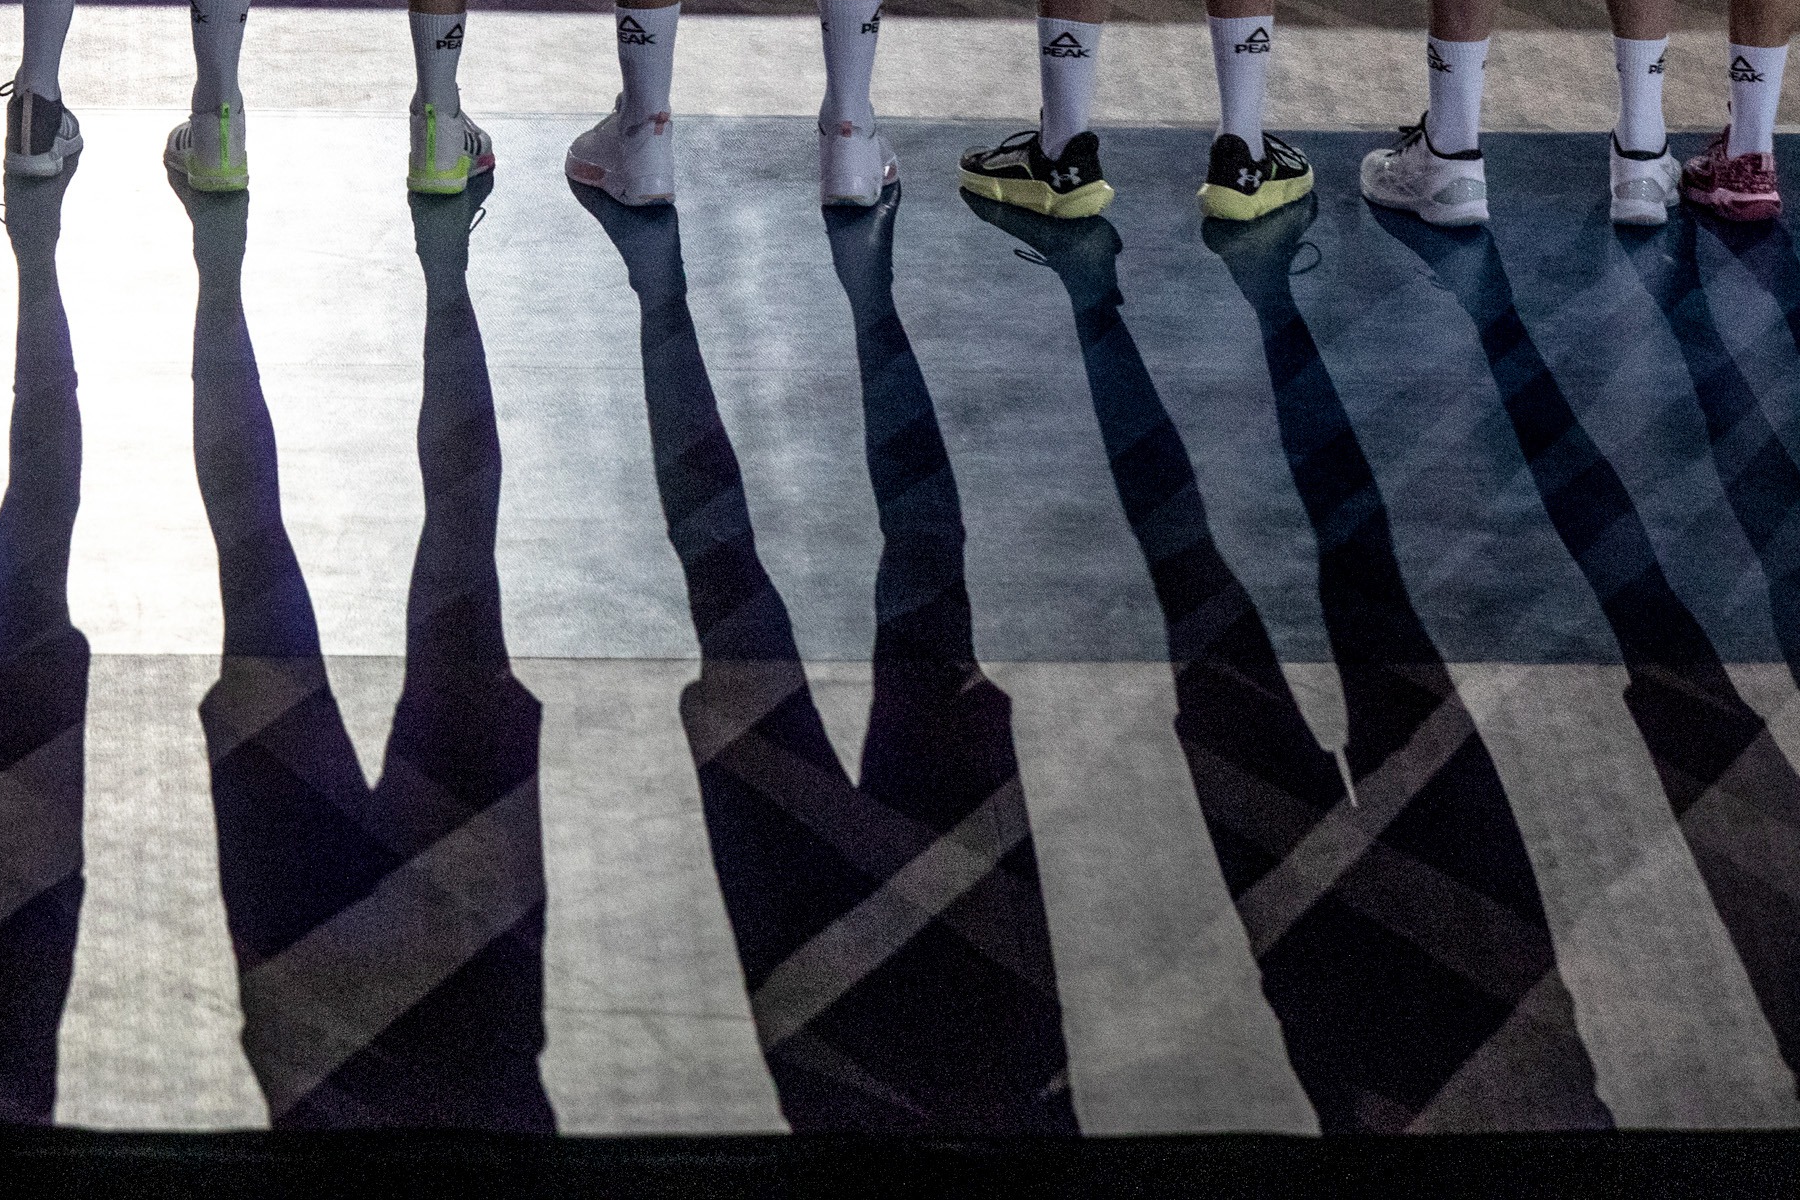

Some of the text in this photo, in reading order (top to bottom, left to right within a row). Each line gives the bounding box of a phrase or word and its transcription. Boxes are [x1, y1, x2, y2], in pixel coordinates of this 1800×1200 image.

[861, 23, 880, 34] PE
[618, 32, 656, 45] EAK
[436, 40, 462, 51] PEA
[1234, 43, 1270, 54] PEA
[1042, 46, 1090, 58] PEAK
[1648, 64, 1664, 74] PE
